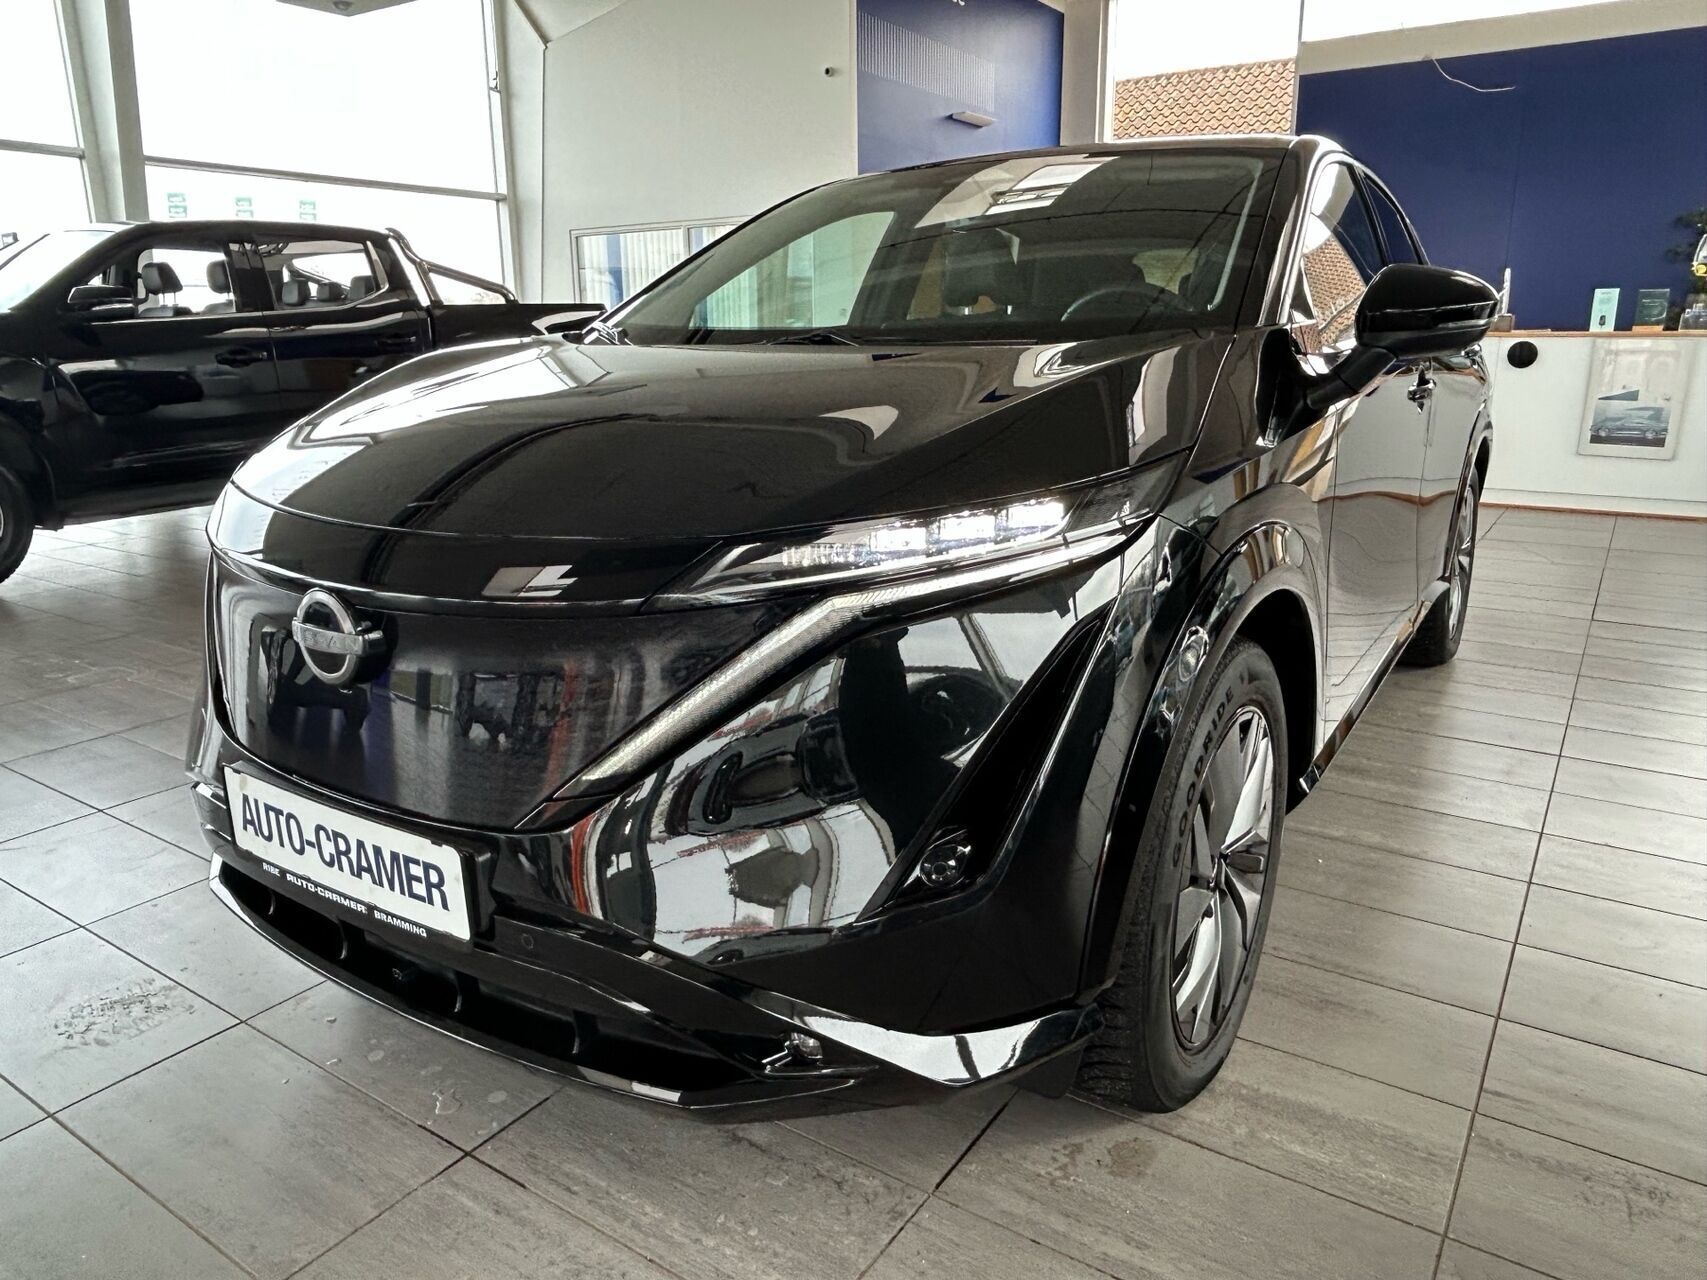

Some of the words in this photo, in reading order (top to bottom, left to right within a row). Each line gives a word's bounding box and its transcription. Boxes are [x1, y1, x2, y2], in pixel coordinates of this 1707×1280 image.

[1173, 687, 1234, 867] GOODRIDE
[242, 793, 450, 911] AUTO-CRAMER
[262, 862, 281, 877] RIBE
[374, 909, 427, 938] BRAMMING
